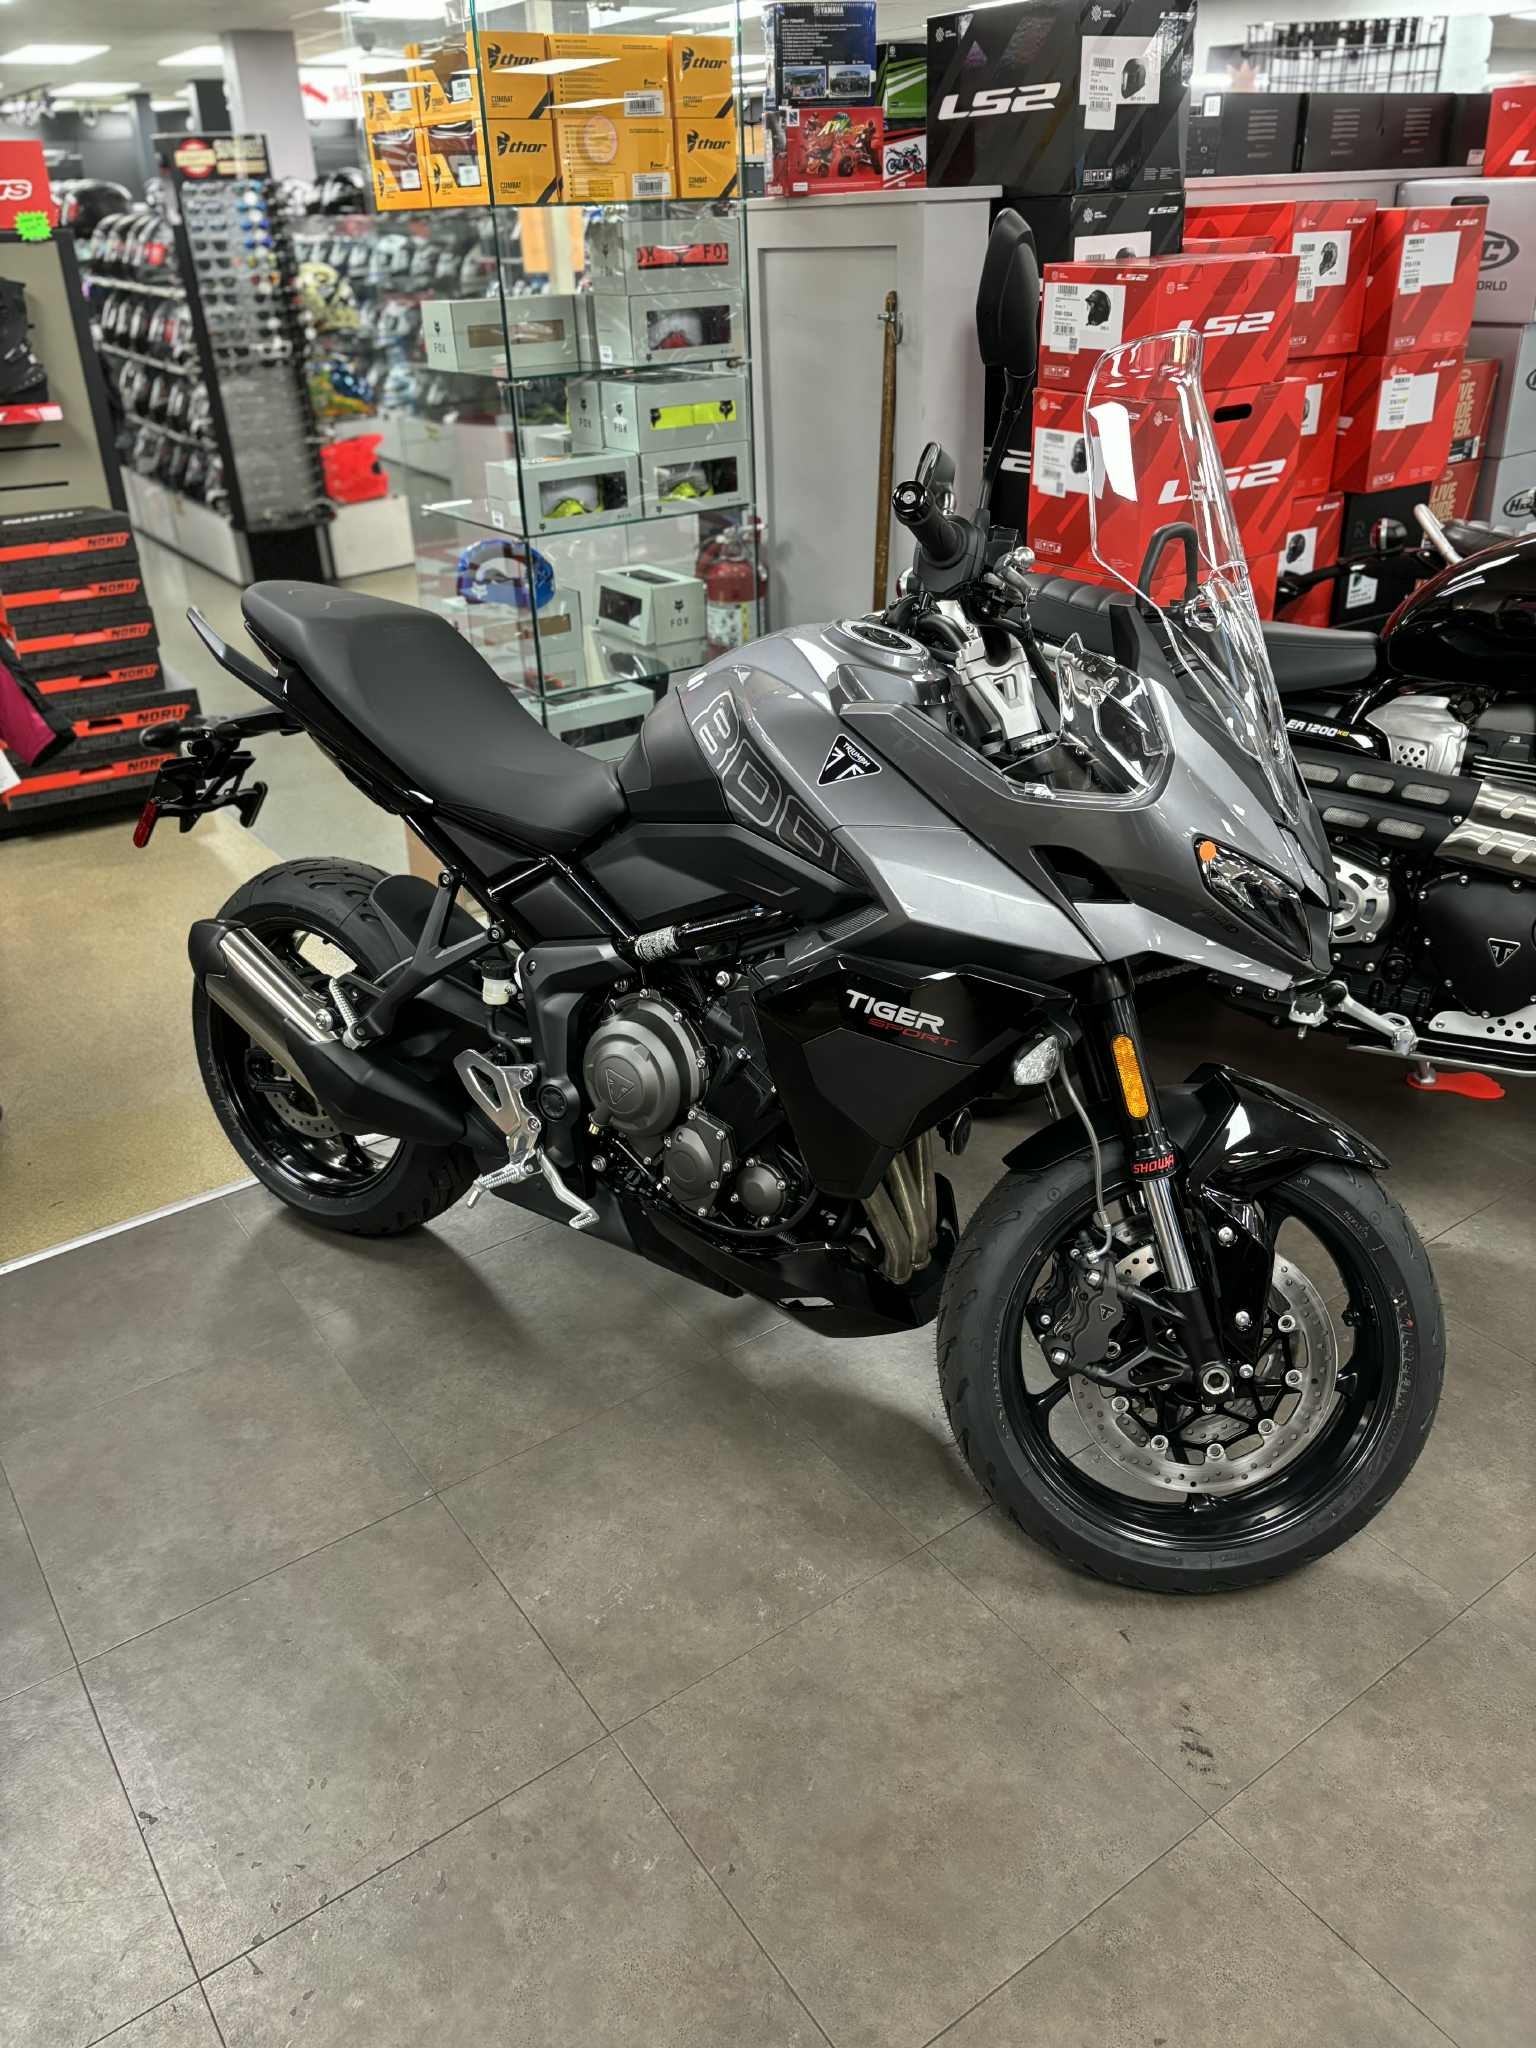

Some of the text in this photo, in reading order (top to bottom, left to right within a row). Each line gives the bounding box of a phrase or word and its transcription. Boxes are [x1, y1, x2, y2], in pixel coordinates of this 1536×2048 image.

[820, 6, 844, 15] YAMAHA
[692, 57, 728, 69] thor
[938, 82, 1061, 120] LS2
[509, 140, 548, 153] thor
[698, 138, 731, 150] thor
[1148, 206, 1179, 215] LS2
[703, 242, 728, 261] FO
[1116, 273, 1149, 281] LS2
[1476, 280, 1508, 291] ORLD
[87, 535, 127, 547] NORU
[98, 581, 136, 593] NORU
[111, 625, 147, 638] NORU
[117, 666, 154, 680] NORU
[137, 708, 184, 724] NORU
[1305, 723, 1338, 737] 1200
[842, 741, 871, 768] TRIUMPH
[846, 988, 945, 1035] TIGER
[867, 1018, 959, 1047] SPORT
[1133, 1153, 1175, 1174] SHOWA
